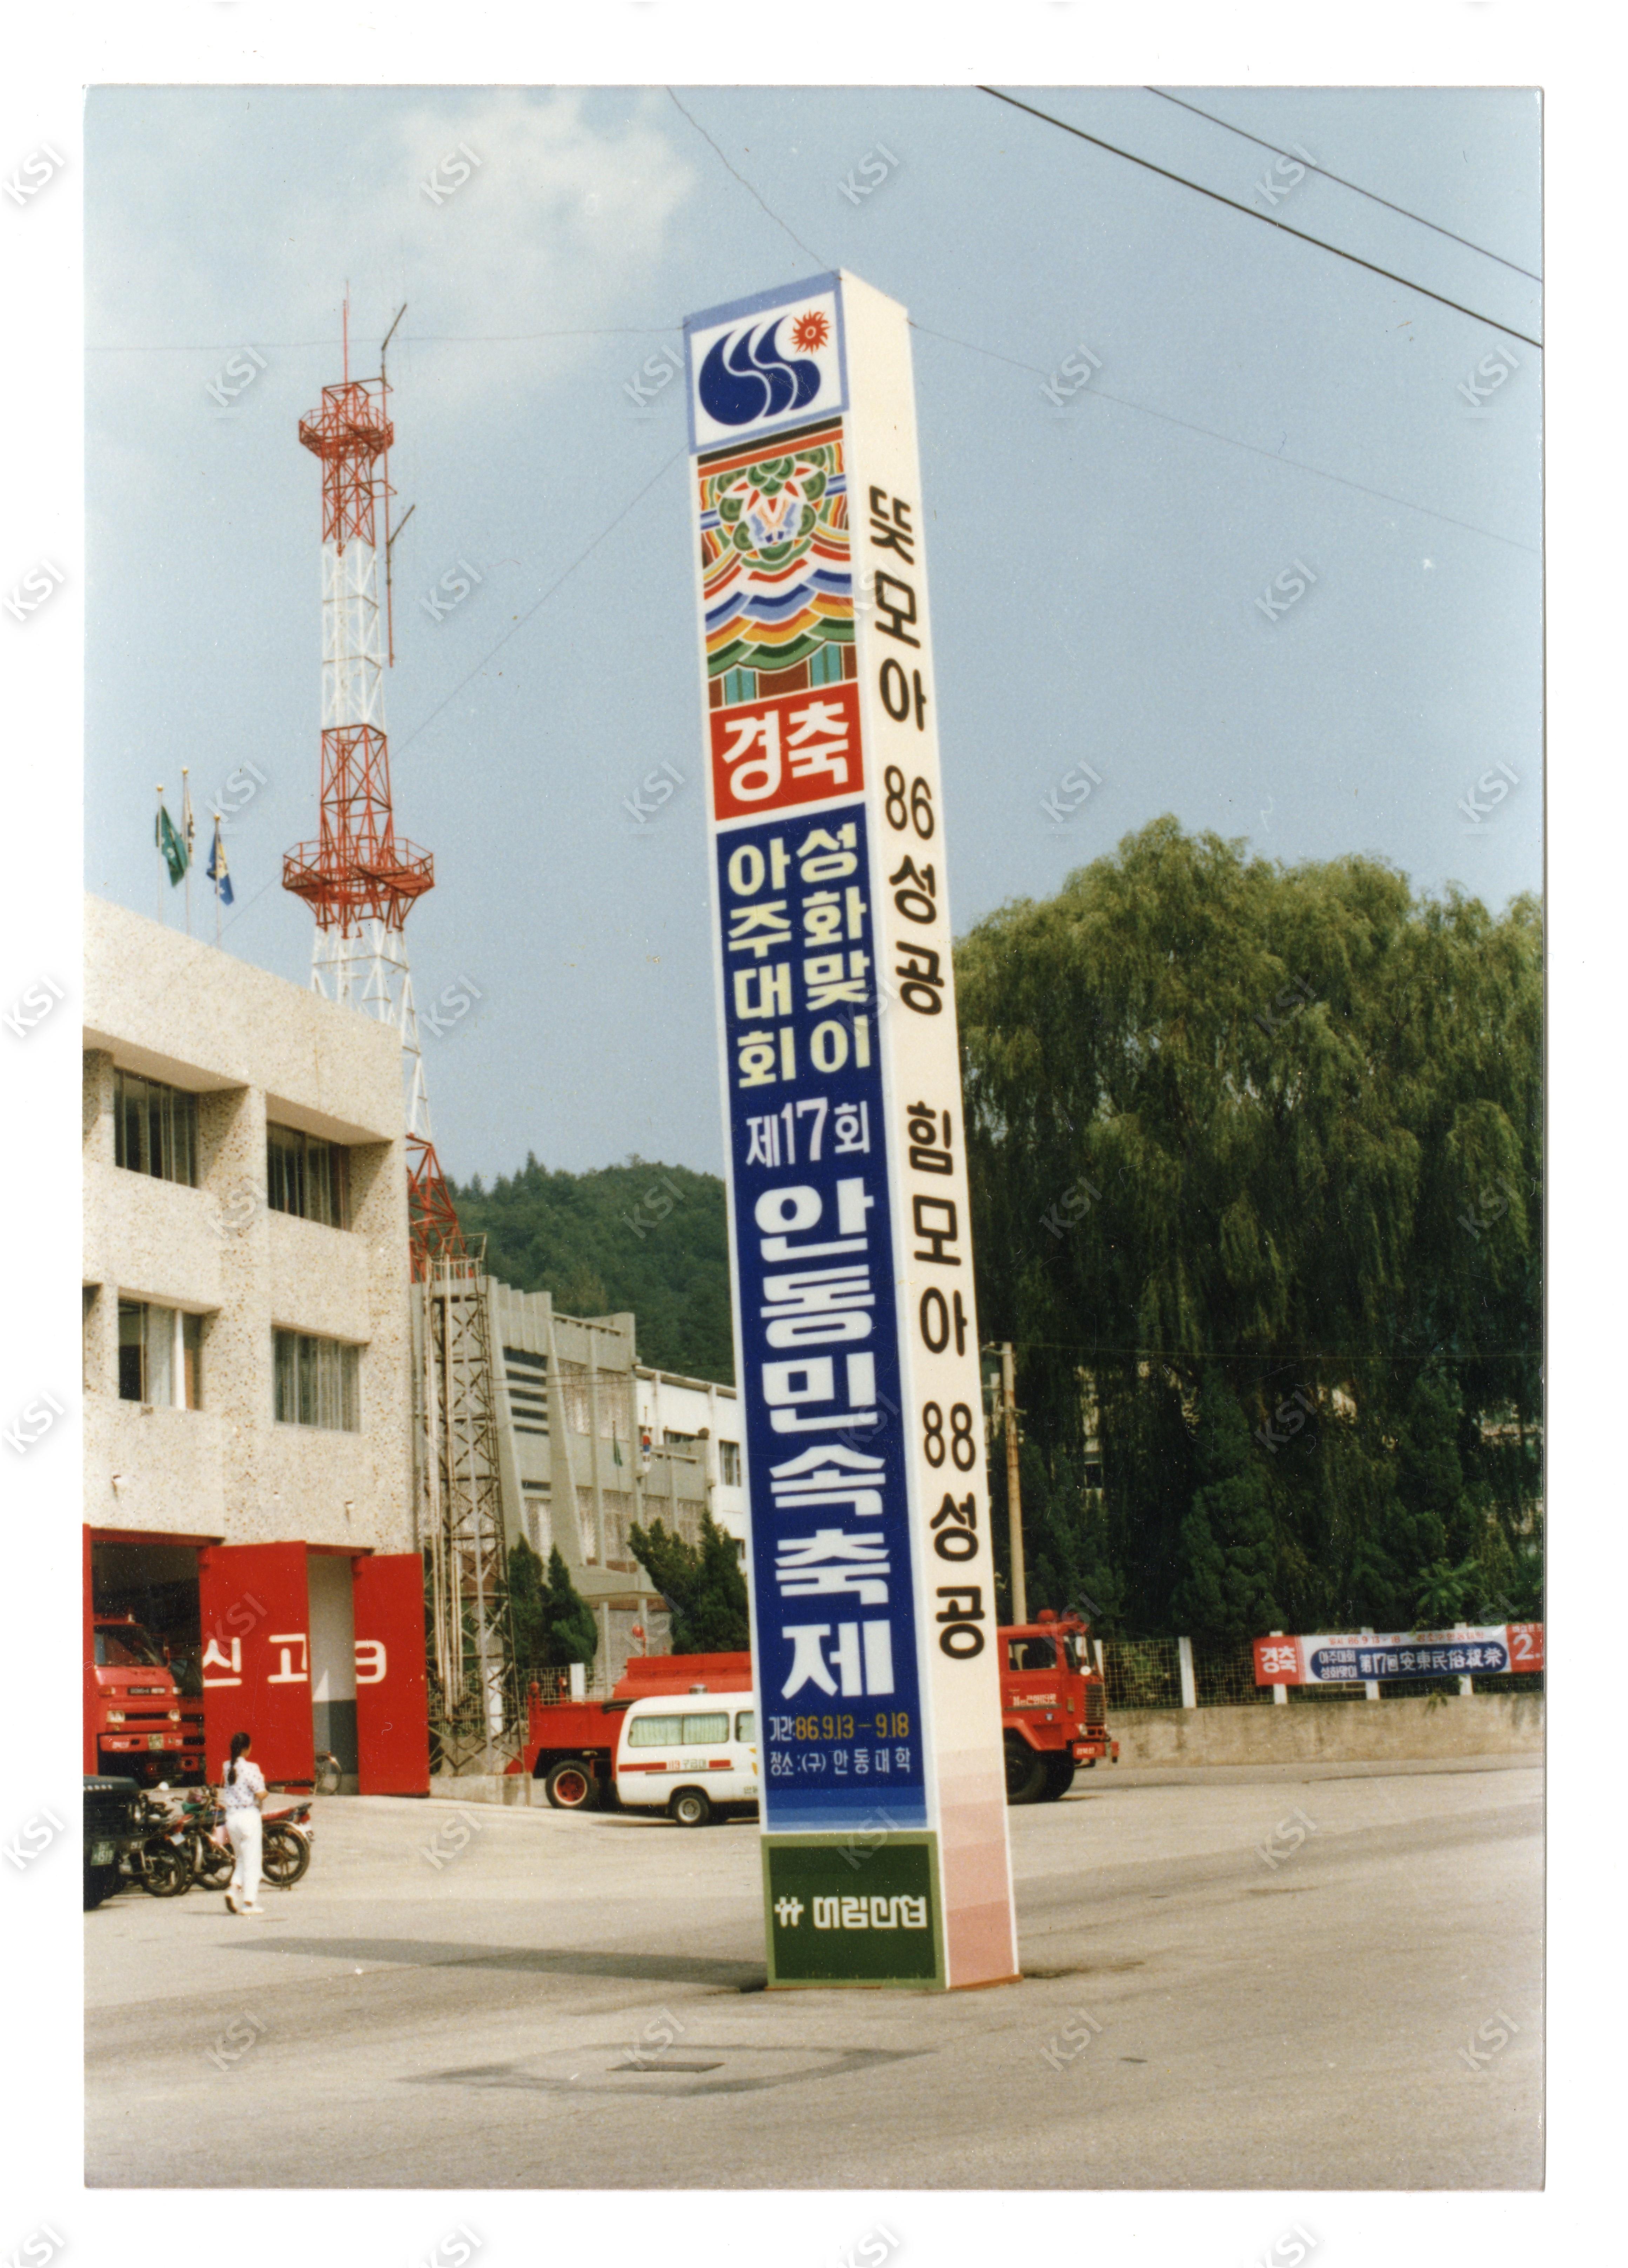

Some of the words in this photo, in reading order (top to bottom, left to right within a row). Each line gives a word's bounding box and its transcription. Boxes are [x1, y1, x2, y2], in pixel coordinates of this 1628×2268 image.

[721, 701, 849, 802] 경축
[746, 1096, 871, 1168] 제17회
[1260, 1646, 1297, 1673] 경축
[1319, 1649, 1356, 1664] 아주대회
[1320, 1665, 1357, 1679] 성화맞이
